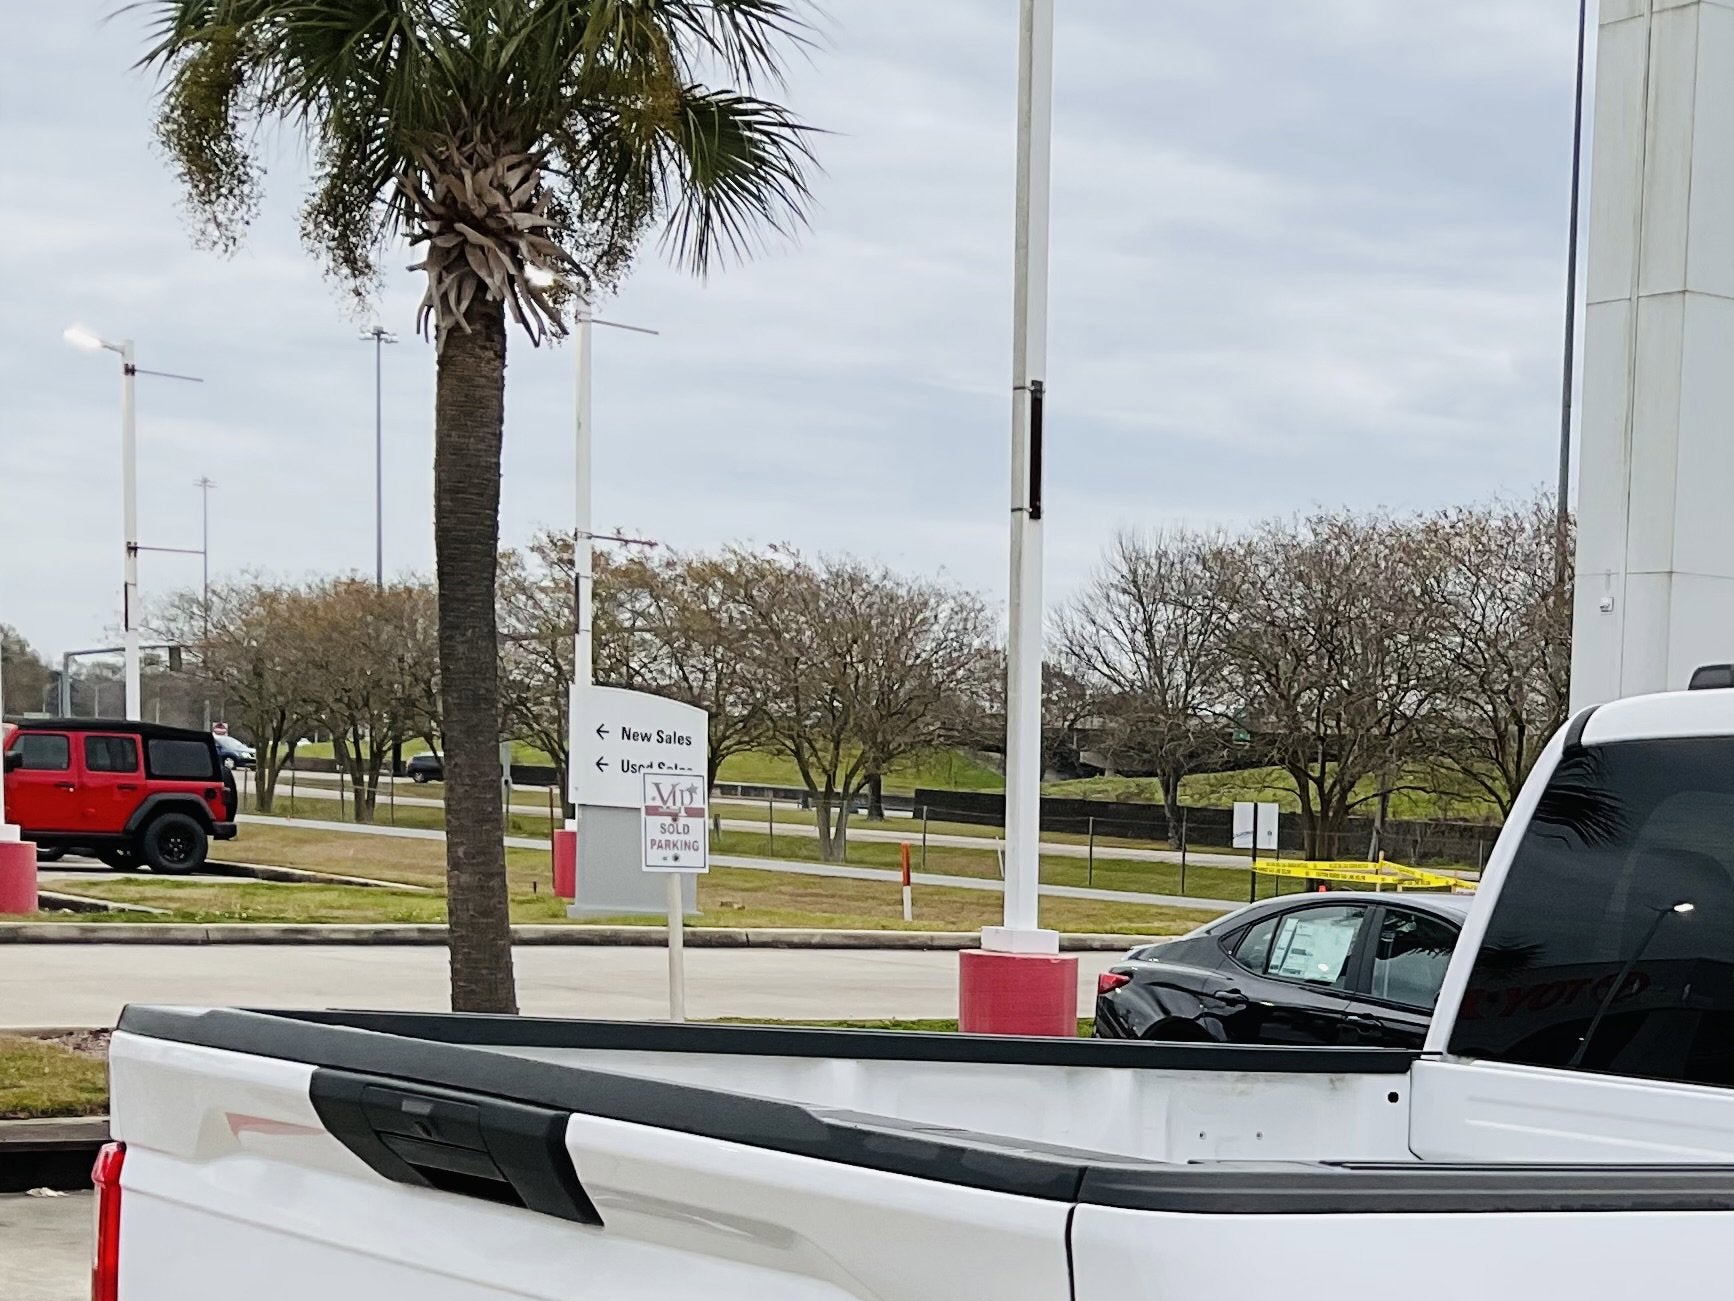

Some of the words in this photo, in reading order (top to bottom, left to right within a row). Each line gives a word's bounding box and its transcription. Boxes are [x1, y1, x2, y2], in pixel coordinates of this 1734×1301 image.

[621, 726, 653, 742] New
[656, 729, 692, 746] Sales
[660, 822, 690, 835] SOLD
[650, 838, 700, 852] PARKING
